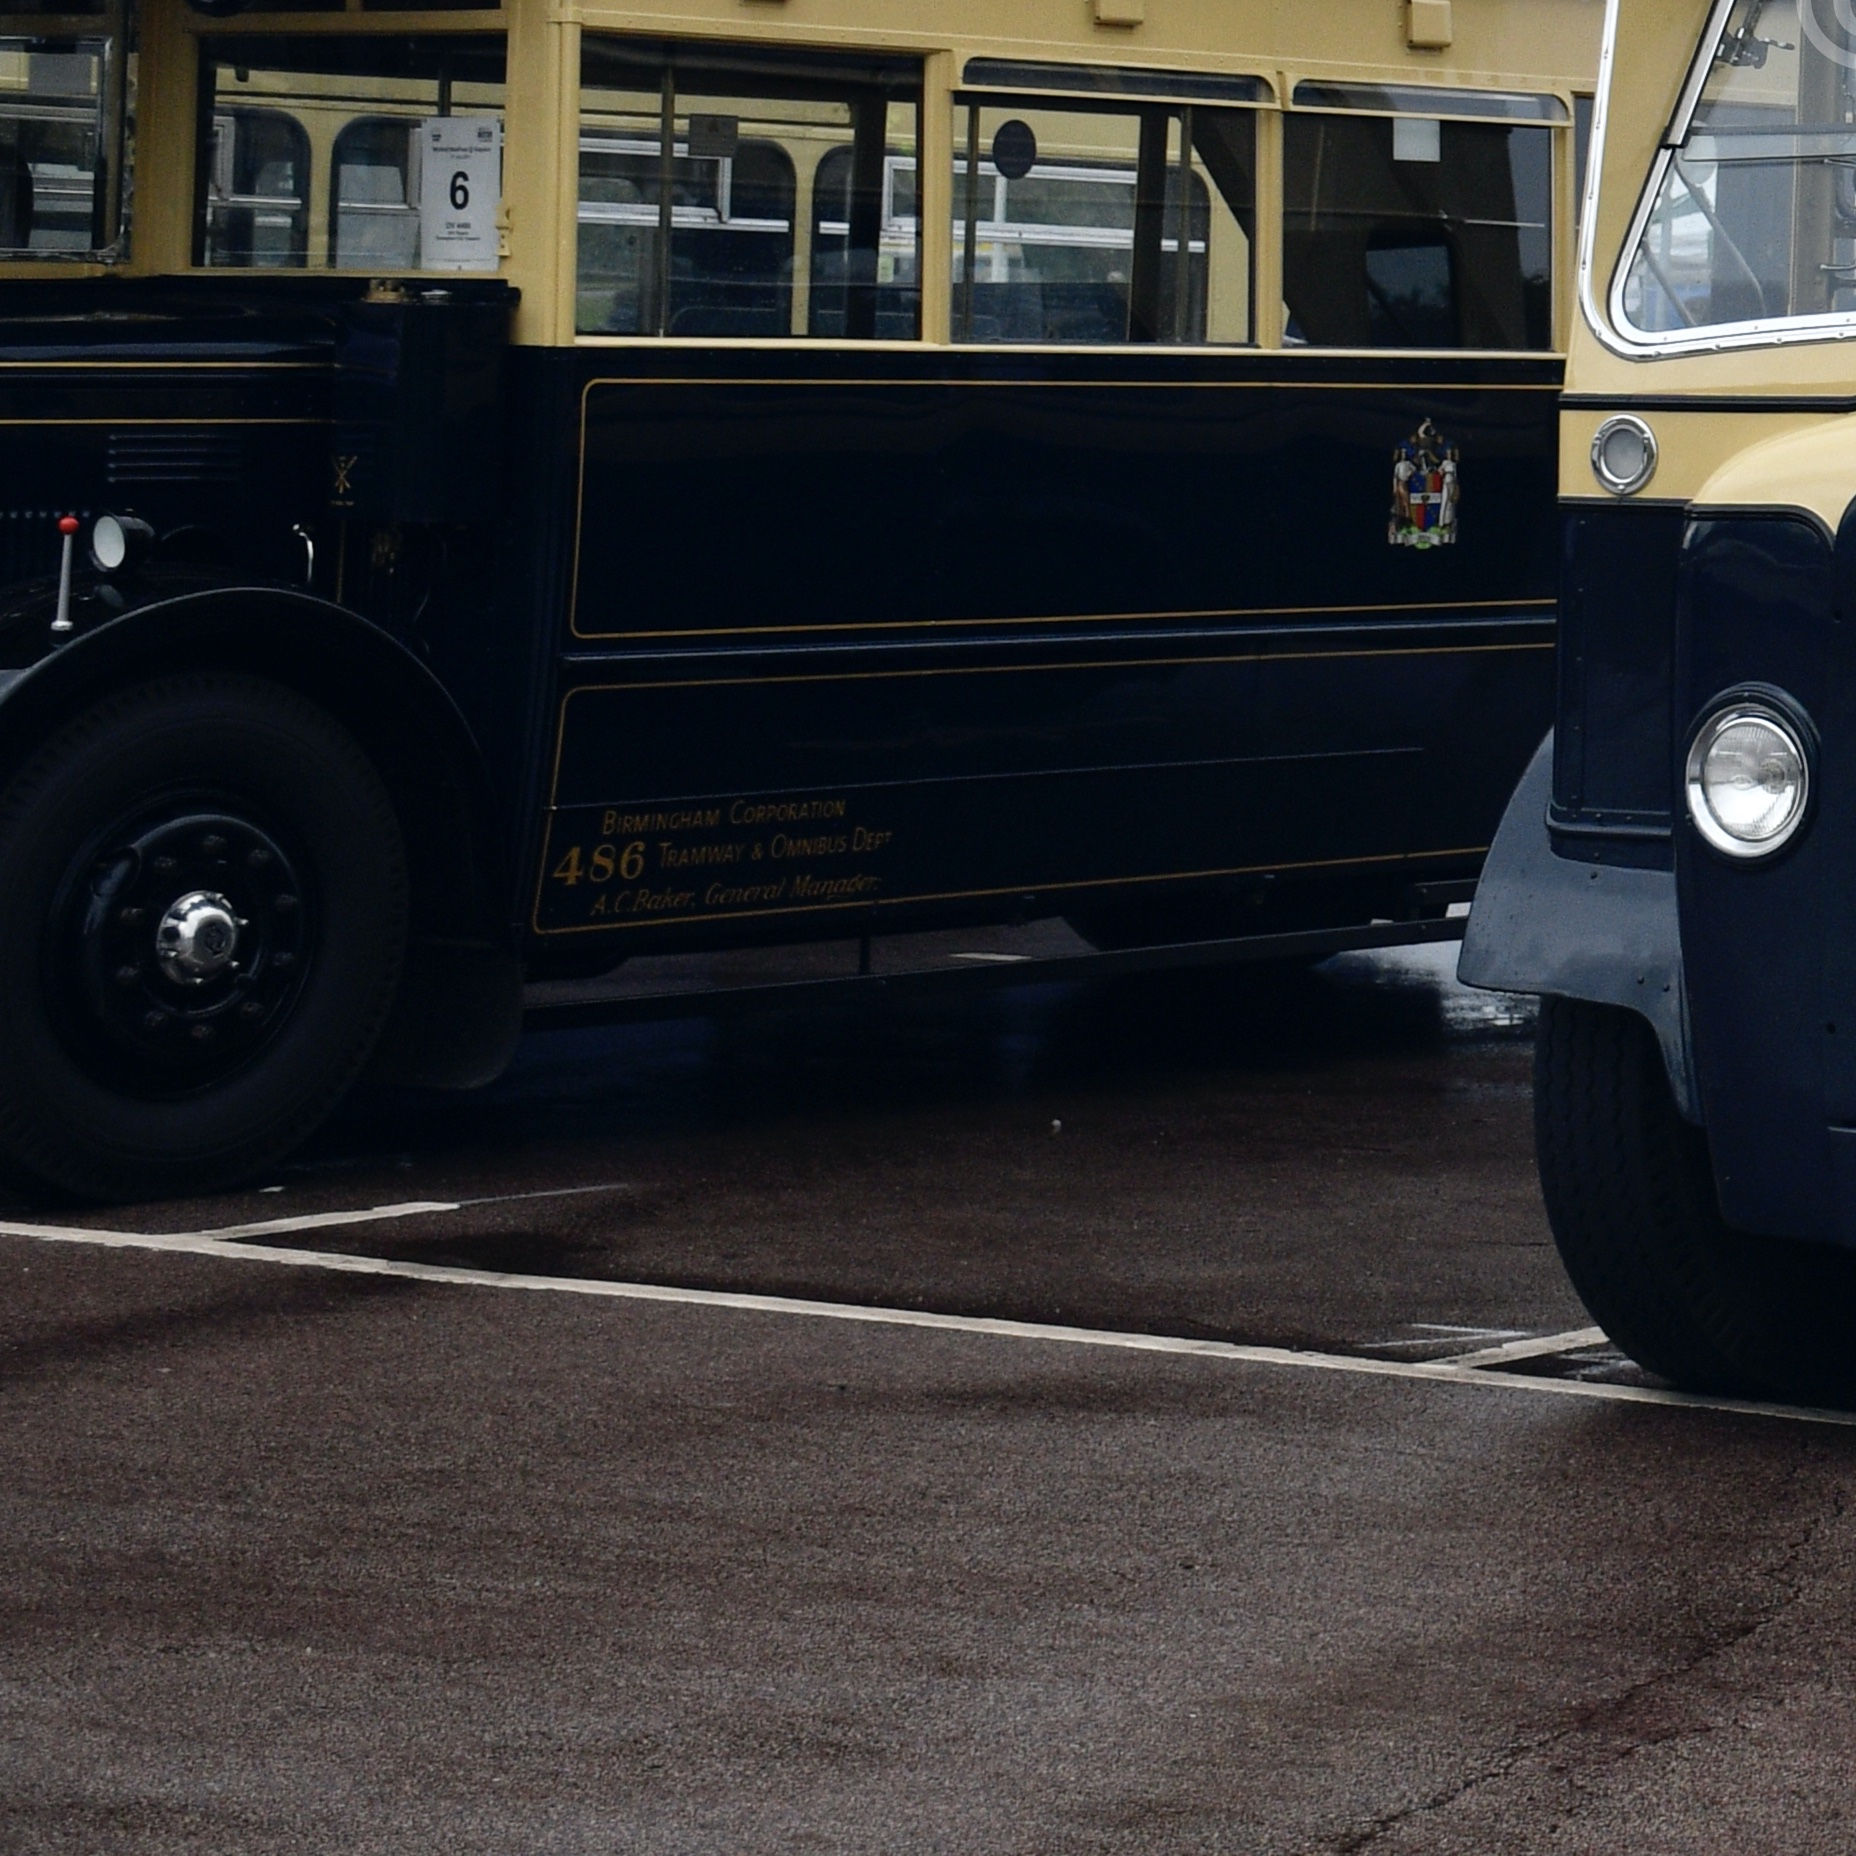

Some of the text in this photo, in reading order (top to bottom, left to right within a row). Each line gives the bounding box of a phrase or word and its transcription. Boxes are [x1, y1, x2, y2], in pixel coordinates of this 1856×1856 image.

[450, 171, 469, 210] 6
[553, 841, 646, 885] 486
[751, 846, 762, 861] &
[705, 876, 786, 905] General
